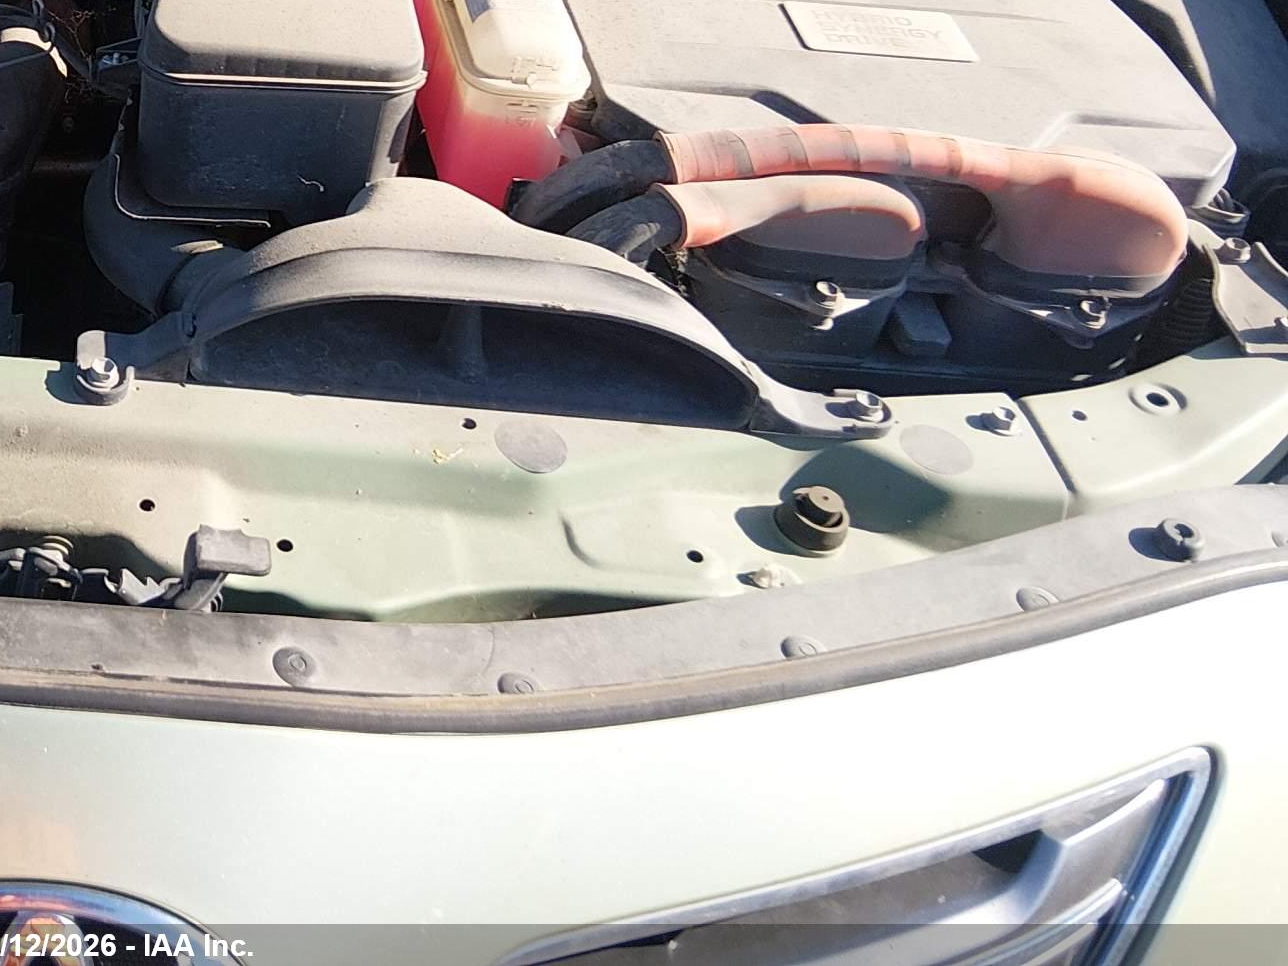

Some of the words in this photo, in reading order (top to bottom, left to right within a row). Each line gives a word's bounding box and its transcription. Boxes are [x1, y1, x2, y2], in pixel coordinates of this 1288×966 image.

[811, 9, 913, 27] HYBRID
[816, 20, 944, 40] SYNERGY
[825, 34, 907, 48] DRIVE
